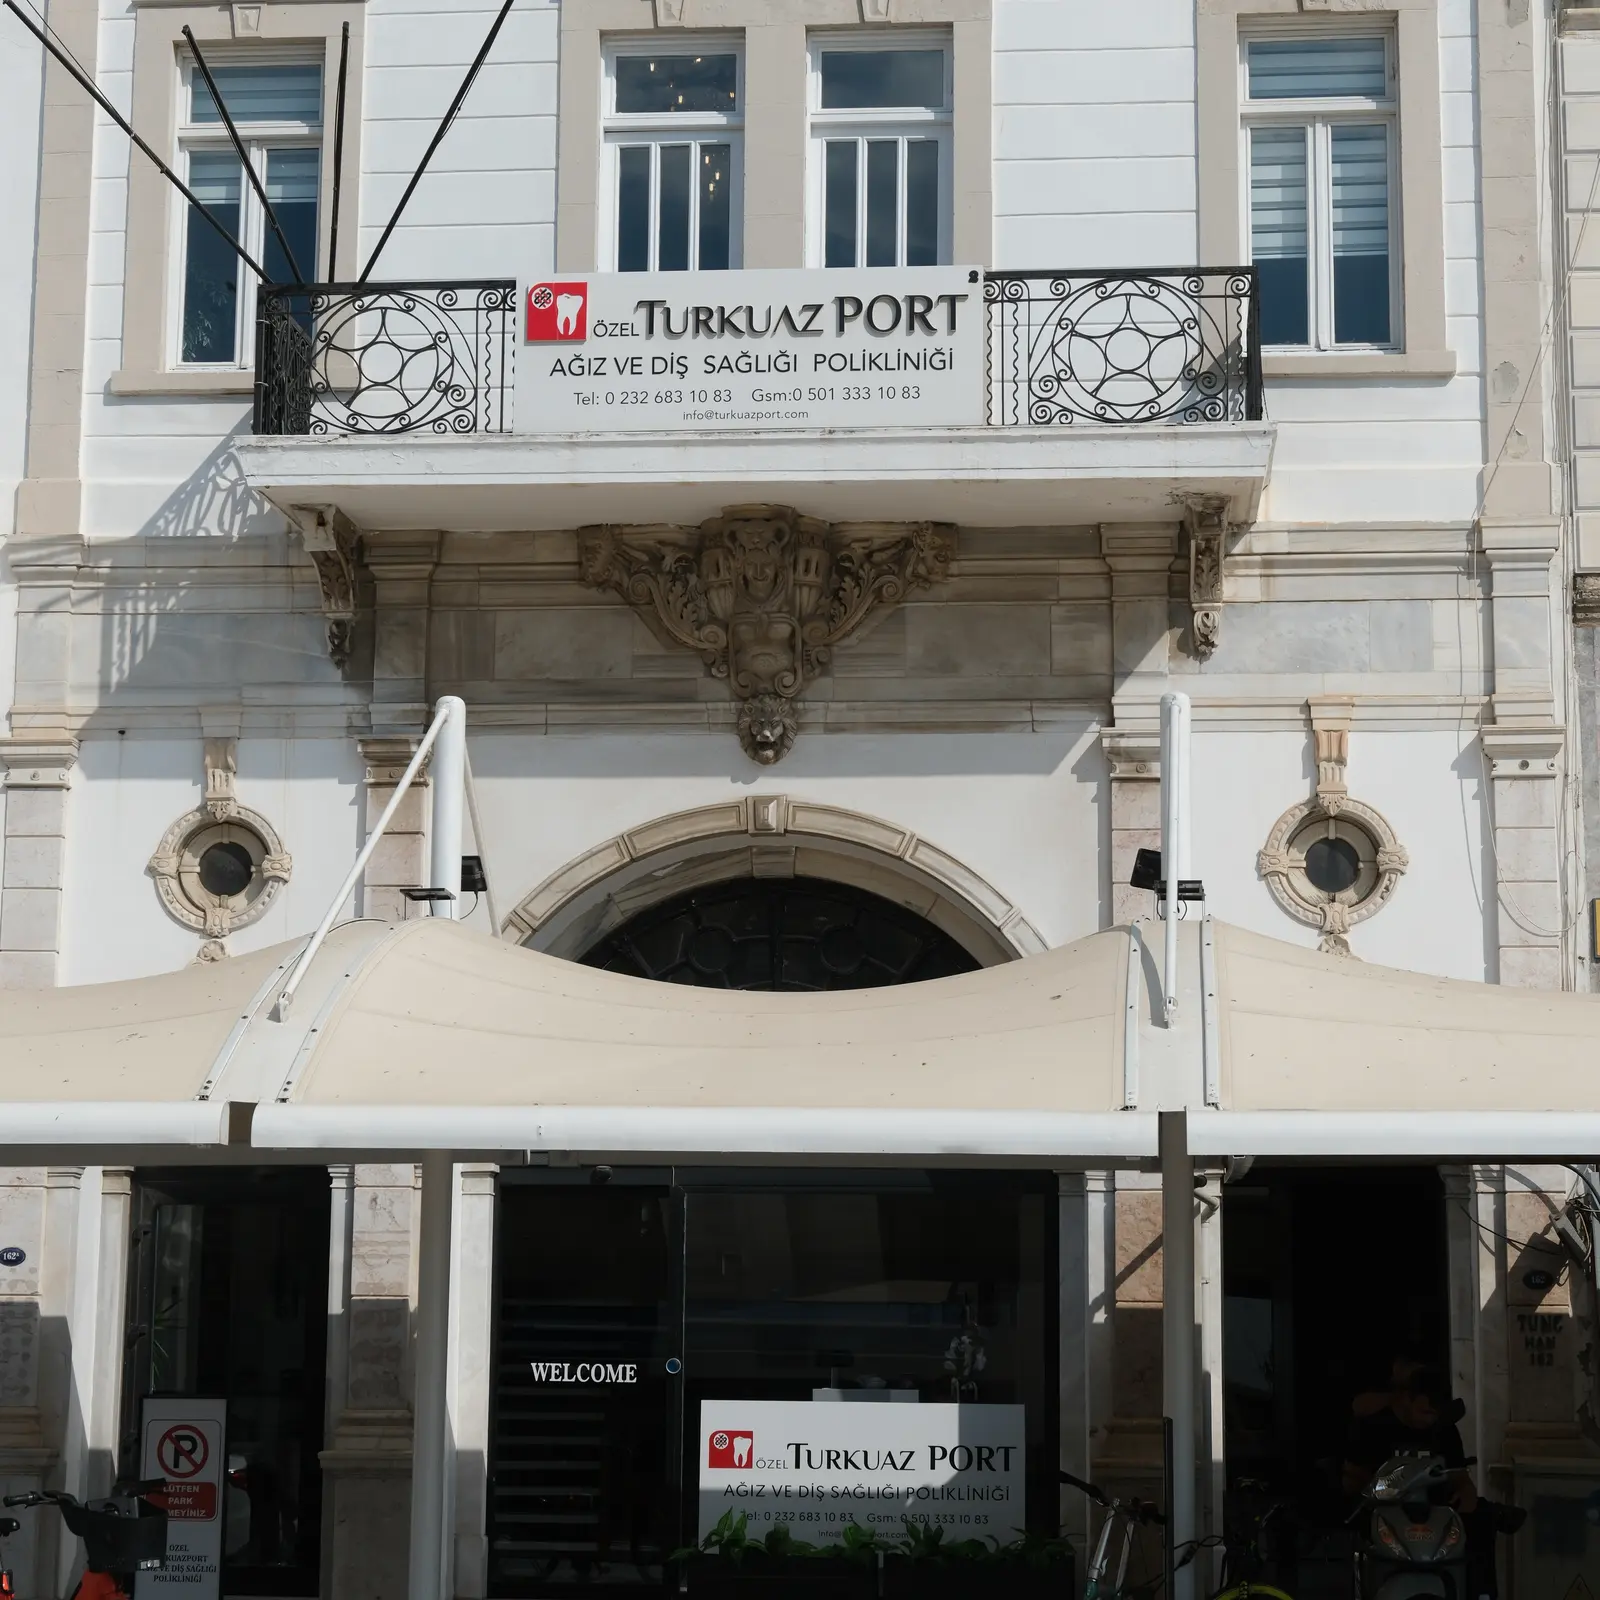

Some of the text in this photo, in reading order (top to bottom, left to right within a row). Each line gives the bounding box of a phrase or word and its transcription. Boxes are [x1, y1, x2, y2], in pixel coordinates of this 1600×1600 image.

[593, 294, 969, 338] ÖZEL TURKUAZ PORT
[550, 347, 953, 380] AĞIZ VE DİŞ SAĞLIĞI POLİKLİNİĞİ
[573, 391, 600, 406] Tel:
[605, 391, 615, 405] 0
[620, 391, 649, 405] 232
[654, 390, 683, 404] 683
[690, 390, 707, 403] 10
[713, 389, 732, 403] 83
[808, 387, 835, 401] 501
[842, 386, 871, 400] 333
[878, 386, 896, 399] 10
[901, 386, 921, 399] 83
[683, 409, 809, 421] info@turkuazport.com
[531, 1362, 637, 1383] WELCOME
[756, 1443, 1017, 1472] ÖZEL TURKUAZ PORT
[168, 1496, 193, 1505] PARK
[724, 1481, 1010, 1502] AĞIZ VE DİŞ SAĞLIĞI POLİKLİNİĞİ
[764, 1511, 771, 1521] 0
[774, 1511, 795, 1521] 232
[799, 1511, 820, 1522] 683
[825, 1512, 836, 1522] 10
[839, 1512, 854, 1522] 83
[866, 1512, 897, 1523] Gsm:
[911, 1513, 930, 1524] 501
[934, 1514, 955, 1524] 333
[959, 1514, 971, 1524] 10
[974, 1514, 989, 1525] 83
